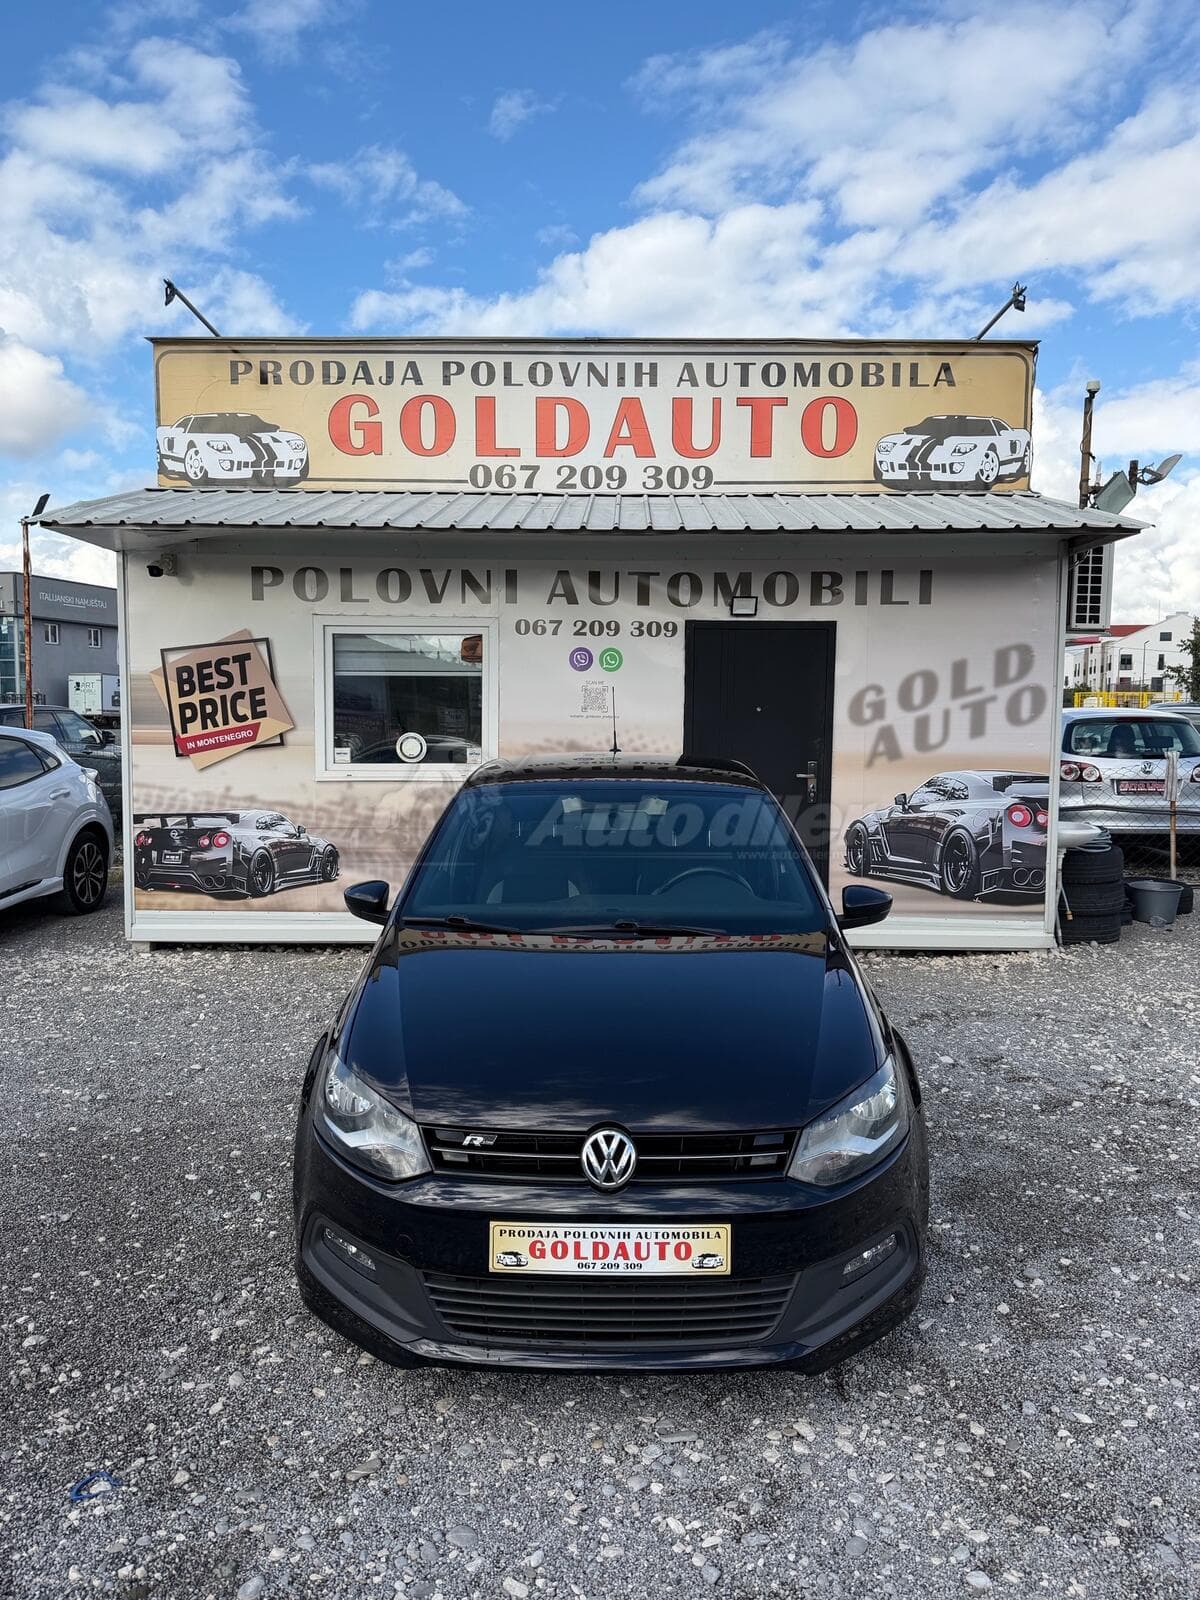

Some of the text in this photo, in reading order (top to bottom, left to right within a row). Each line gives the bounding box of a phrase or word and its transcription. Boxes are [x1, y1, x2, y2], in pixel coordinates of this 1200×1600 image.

[229, 360, 955, 387] PRODAJA POLOVNIH AUTOMOBILA
[328, 394, 859, 459] GOLDAUTO
[469, 464, 714, 490] 067 209 309
[250, 566, 933, 607] POLOVNI AUTOMOBILI
[515, 619, 678, 637] 067 209 309
[176, 652, 252, 698] BEST
[847, 643, 1036, 727] GOLD
[178, 686, 267, 734] PRICE
[866, 682, 1047, 768] AUTO
[186, 729, 254, 750] IN MONTENEGRO
[499, 1229, 722, 1240] PRODAJA POLOVNIH AUTOMOBILA
[528, 1239, 692, 1261] GOLDAUTO
[578, 1262, 599, 1270] 067
[600, 1262, 620, 1270] 209
